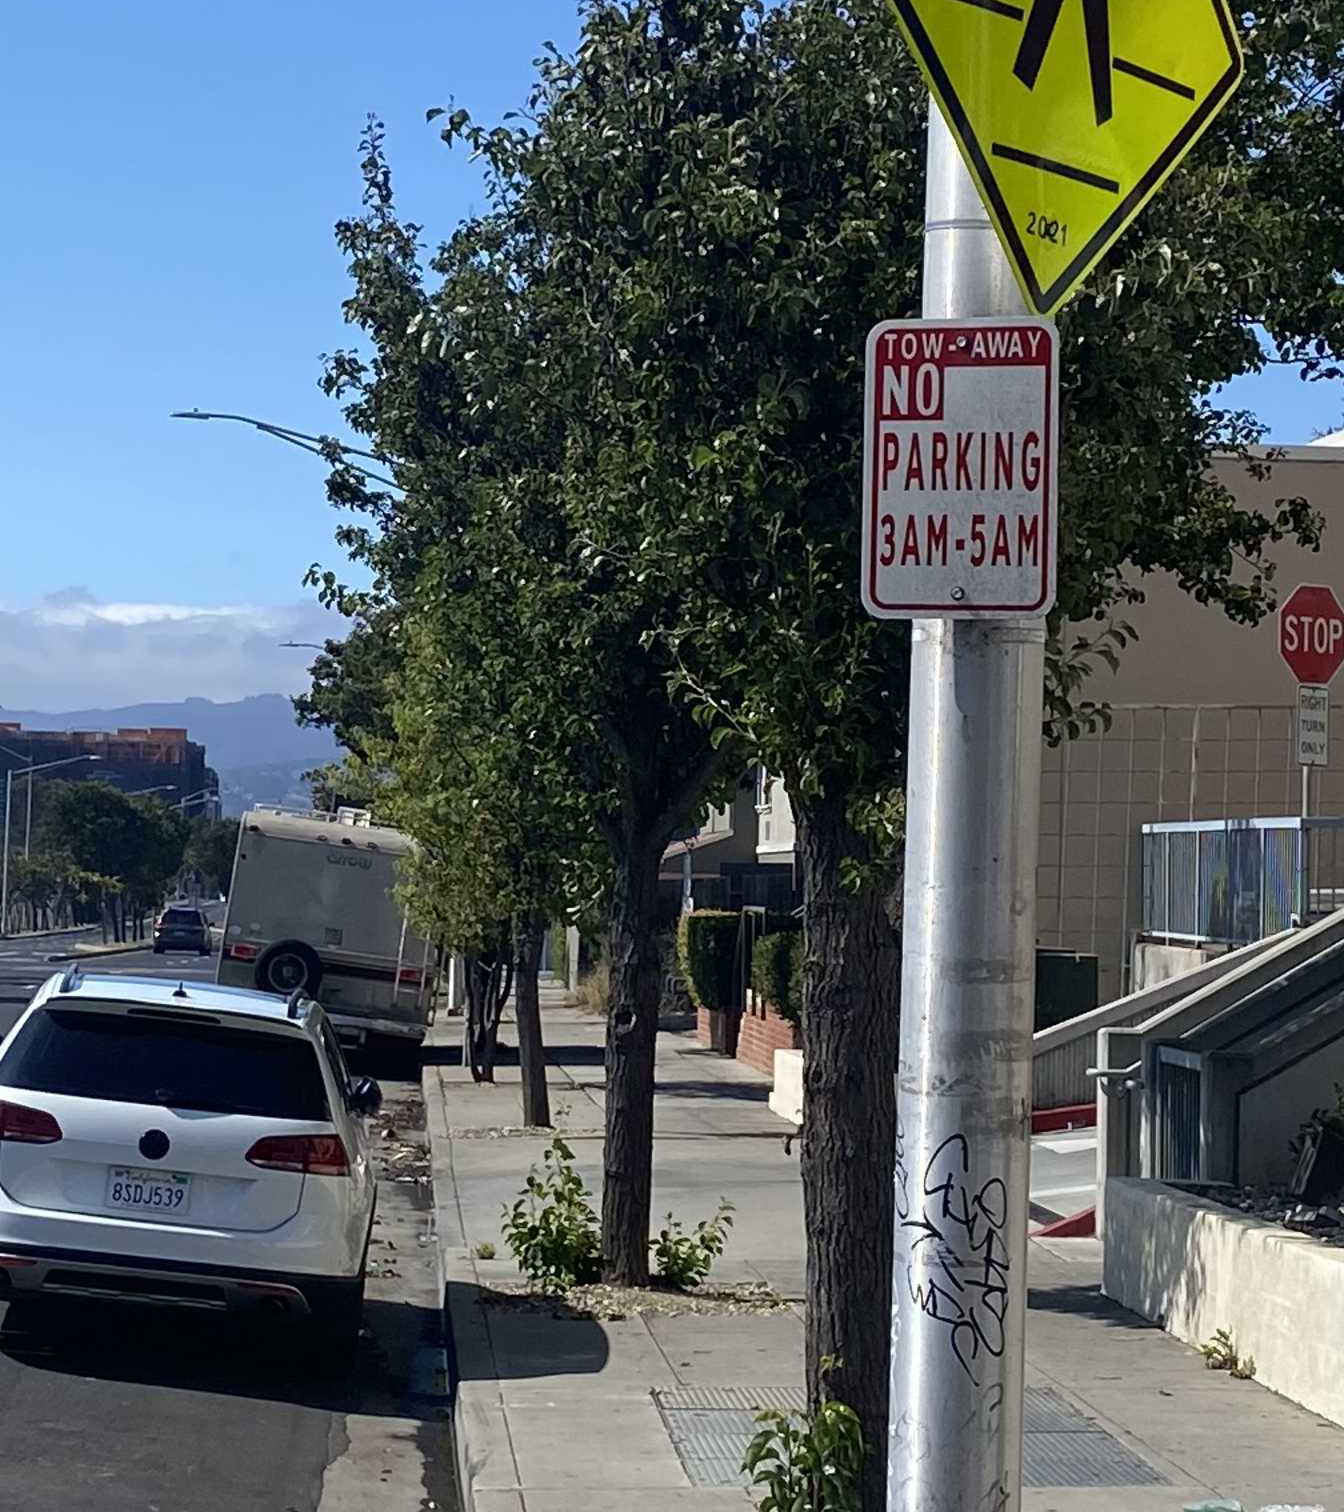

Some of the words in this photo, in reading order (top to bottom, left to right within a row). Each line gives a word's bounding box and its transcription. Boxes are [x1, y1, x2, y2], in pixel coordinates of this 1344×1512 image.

[882, 363, 940, 417] NO
[882, 431, 1041, 492] PARKING
[879, 513, 1040, 567] 3AM-5AM
[1284, 615, 1343, 654] STOP
[1301, 694, 1326, 710] RIGHT
[1301, 719, 1325, 733] TURN
[1301, 742, 1325, 756] ONLY
[112, 1182, 185, 1208] 8SDJ539
